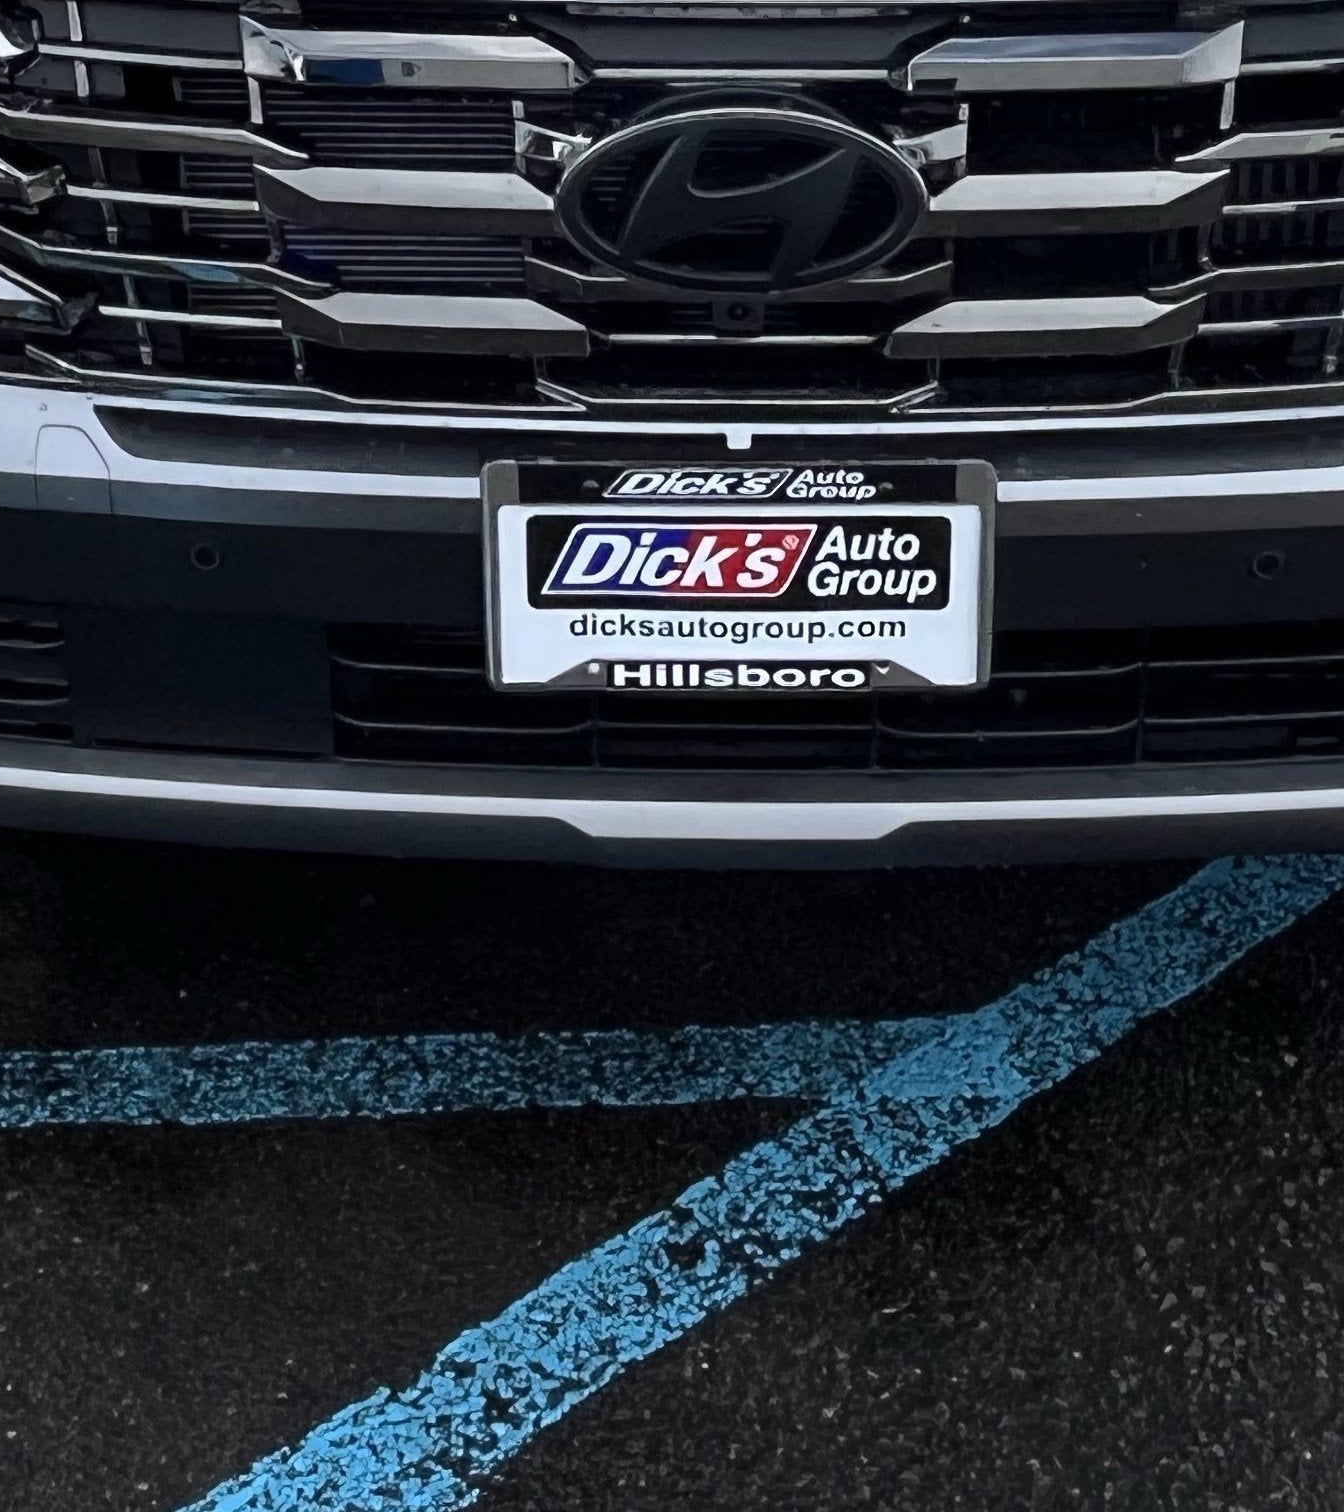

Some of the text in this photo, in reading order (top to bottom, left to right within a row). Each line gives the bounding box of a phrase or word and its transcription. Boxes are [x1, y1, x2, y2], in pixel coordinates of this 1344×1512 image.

[617, 471, 773, 495] Dick's
[797, 469, 865, 485] Auto
[786, 483, 877, 500] Group
[814, 525, 922, 562] Auto
[561, 530, 786, 589] Dick's
[807, 564, 937, 603] Group
[569, 613, 907, 644] dicksautogroup.com
[613, 663, 866, 687] Hillsboro
